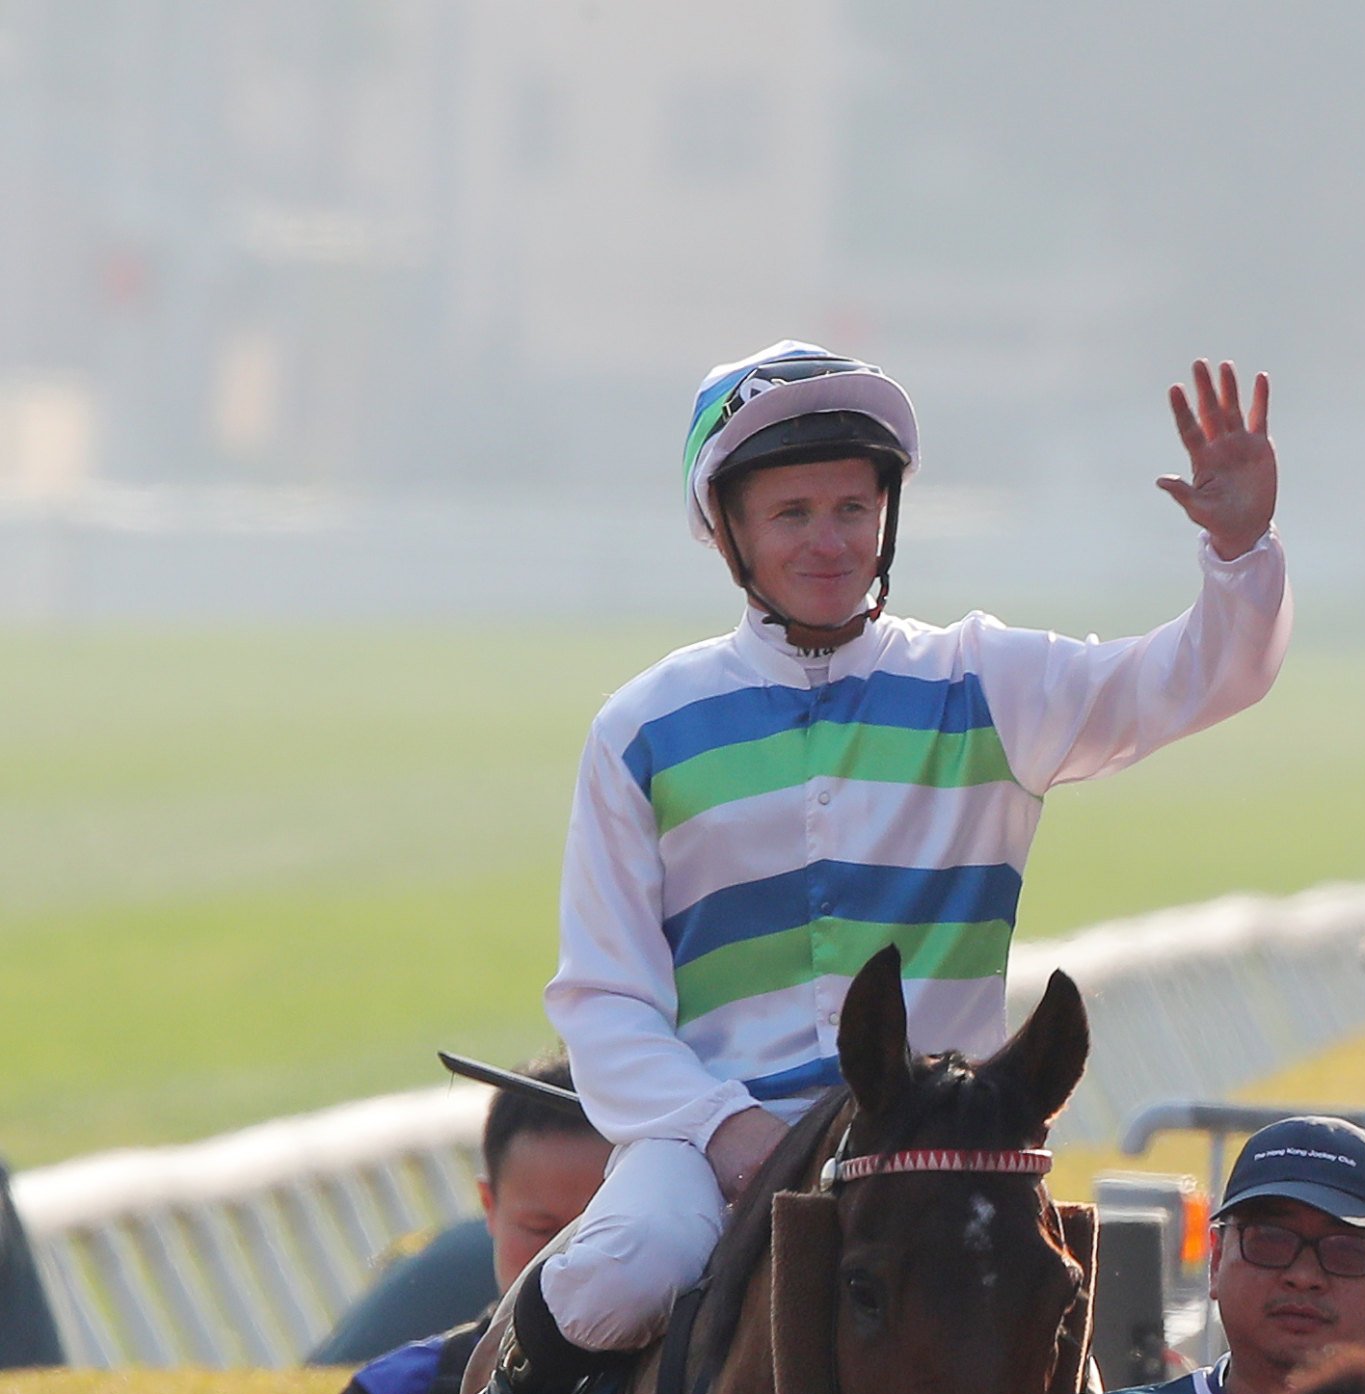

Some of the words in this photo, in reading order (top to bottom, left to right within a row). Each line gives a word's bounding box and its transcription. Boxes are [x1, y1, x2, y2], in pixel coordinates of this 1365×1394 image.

[1266, 1148, 1286, 1157] Hong
[1286, 1147, 1308, 1157] Kong
[1307, 1149, 1337, 1162] Jockey
[1338, 1155, 1357, 1167] Club
